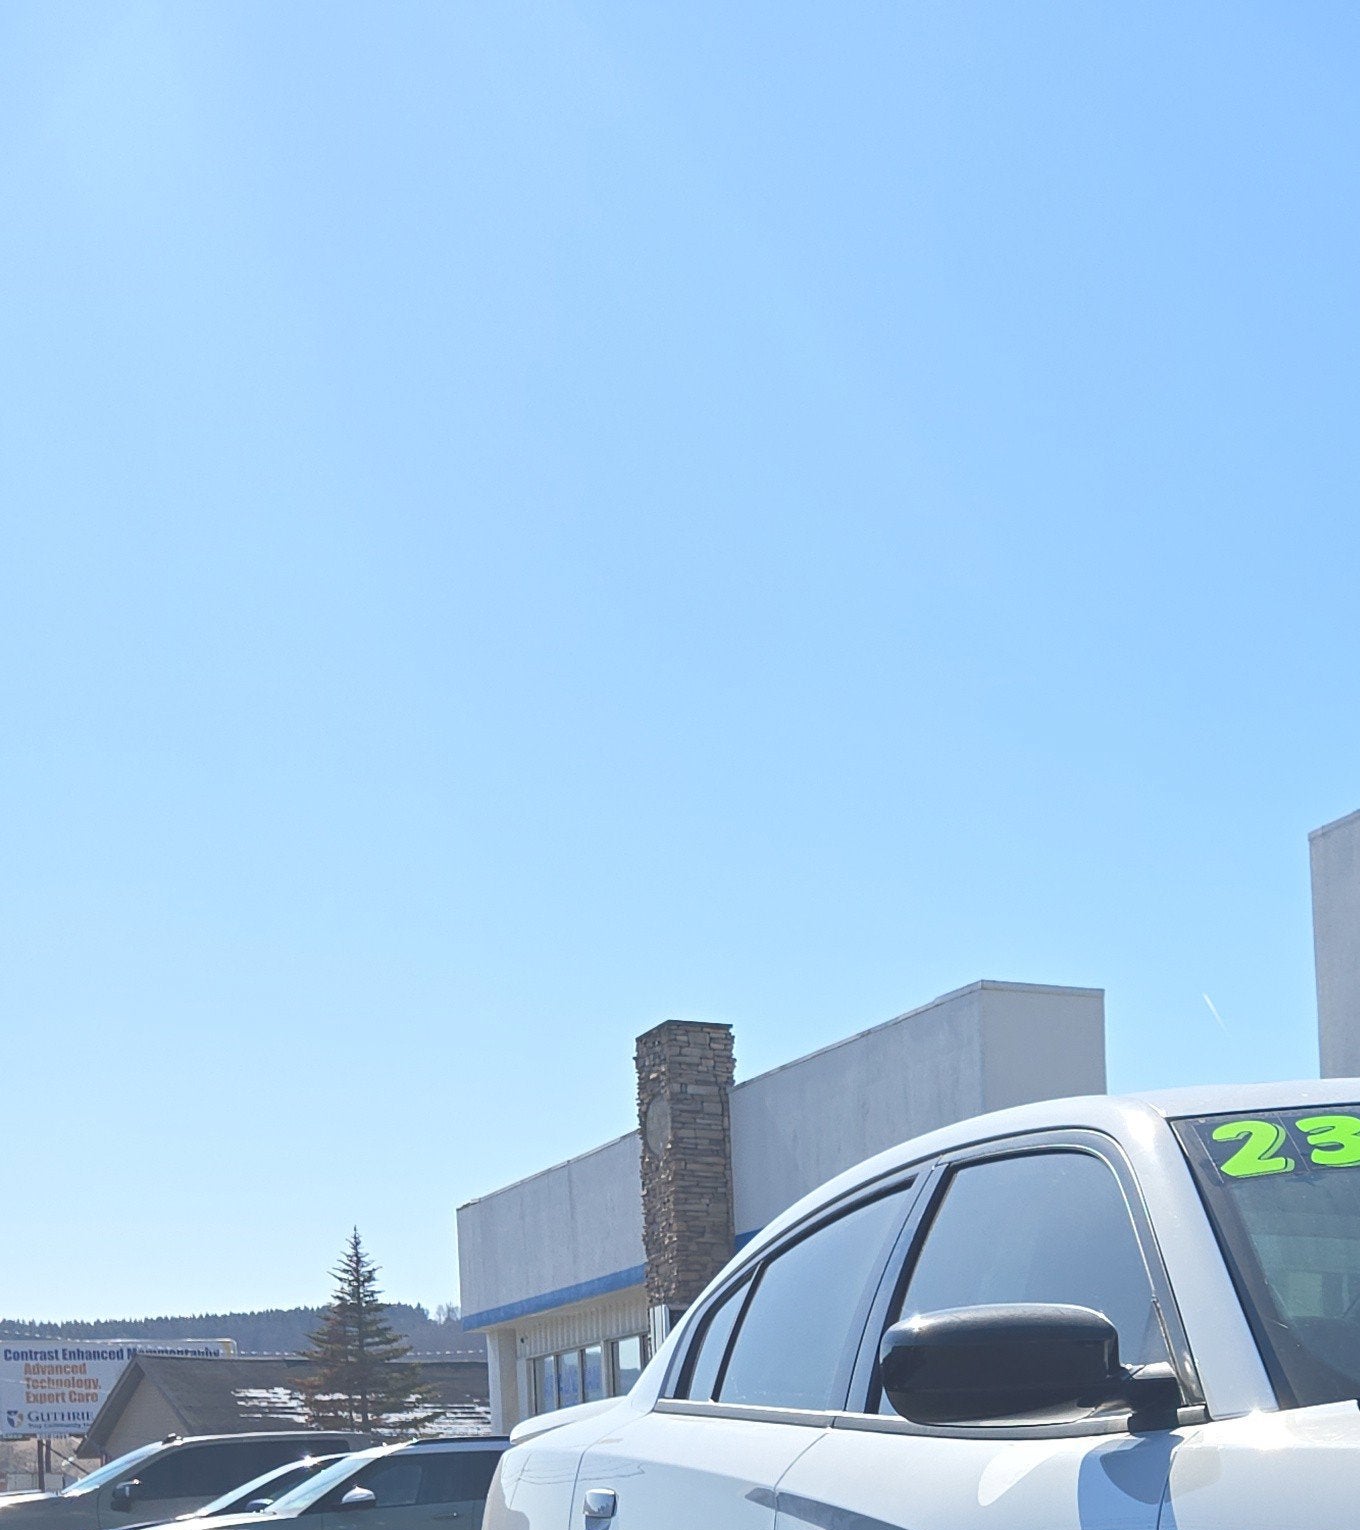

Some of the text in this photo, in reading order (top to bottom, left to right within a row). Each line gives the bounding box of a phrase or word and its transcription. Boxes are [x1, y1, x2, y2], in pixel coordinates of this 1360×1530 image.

[4, 1348, 60, 1361] Contrast
[61, 1347, 125, 1361] Enhanced
[24, 1362, 88, 1376] Advanced
[25, 1390, 99, 1404] Expert Care
